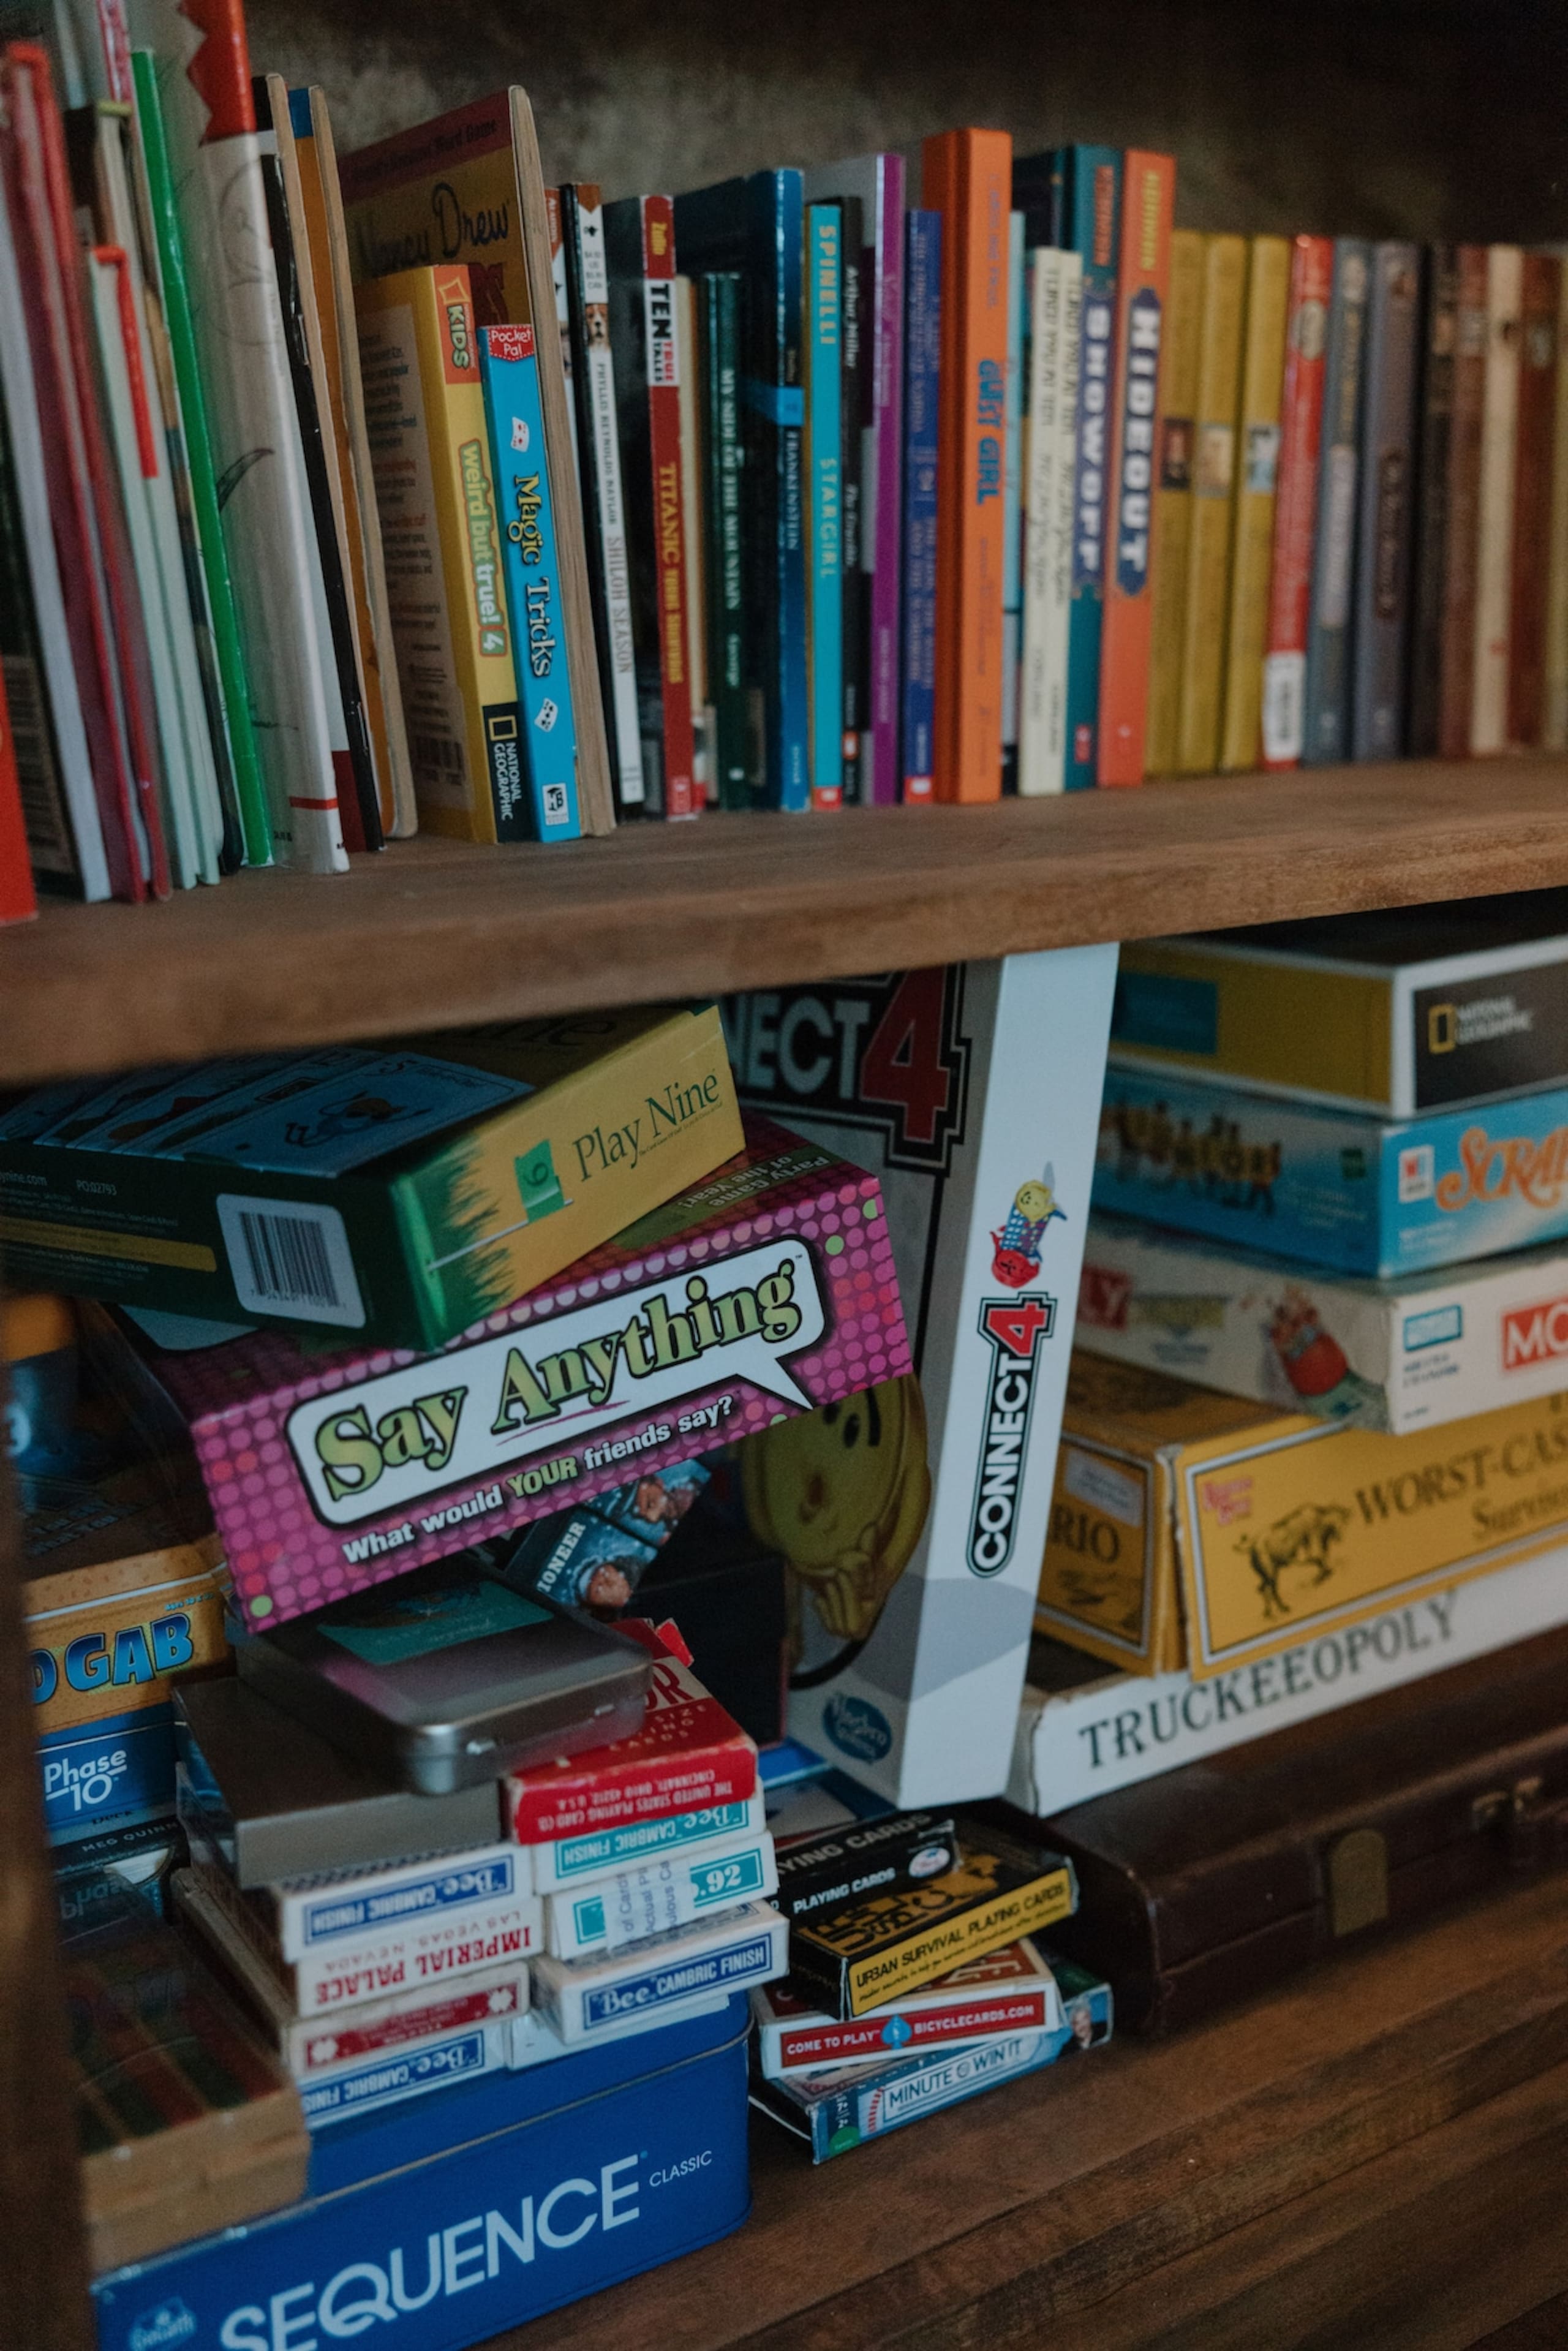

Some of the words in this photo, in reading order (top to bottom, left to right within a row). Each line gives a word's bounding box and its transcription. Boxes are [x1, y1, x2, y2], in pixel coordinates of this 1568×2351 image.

[433, 182, 510, 258] Drew
[819, 225, 837, 345] SPINELLI
[843, 266, 859, 317] Arthur
[491, 329, 532, 344] Pocket
[651, 284, 671, 339] TEN
[448, 304, 470, 370] KIDS
[503, 342, 522, 356] Pal
[653, 342, 663, 381] TALES
[664, 341, 673, 380] TRUE
[844, 319, 859, 368] Miller
[596, 363, 607, 412] PHYLLIS
[719, 369, 736, 396] MY
[600, 415, 614, 475] REYNOLDS
[1079, 306, 1111, 572] SHOWOFF
[1120, 308, 1161, 573] HIDEOUT
[462, 445, 489, 517] weird
[976, 437, 1000, 504] GIRL
[508, 474, 543, 564] Magic
[605, 480, 617, 526] NAYLOR
[658, 462, 680, 565] TITANIC
[819, 458, 839, 578] STARGIRL
[469, 520, 489, 561] but
[475, 563, 501, 624] true!
[606, 537, 625, 601] SHILOH
[483, 632, 503, 651] 4
[525, 577, 556, 677] Tricks
[612, 608, 632, 673] SEASON
[493, 743, 513, 821] GEOGRAPHIC
[506, 742, 521, 804] NATIONAL
[720, 995, 871, 1101] NECT
[861, 964, 949, 1144] 4
[573, 1118, 641, 1182] Play
[645, 1074, 720, 1138] Nine
[730, 1165, 768, 1183] the
[769, 1155, 792, 1169] of
[770, 1156, 830, 1181] Party
[676, 1182, 730, 1209] Year!
[707, 1179, 769, 1206] Game
[985, 1299, 1049, 1357] 4
[315, 1386, 468, 1501] Say
[491, 1259, 802, 1435] Anything
[342, 1522, 415, 1564] What
[420, 1484, 503, 1533] would
[507, 1455, 579, 1498] YOUR
[584, 1423, 672, 1470] friends
[678, 1394, 734, 1434] say?
[973, 1352, 1034, 1572] CONNECT
[536, 1522, 587, 1593] IONEER
[65, 1613, 194, 1691] GAB
[1079, 1585, 1460, 1769] TRUCKEEOPOLY
[44, 1749, 127, 1793] Phase
[73, 1772, 113, 1811] 10
[623, 1781, 652, 1798] OHIO
[673, 1783, 712, 1804] UNITED
[714, 1779, 733, 1796] THE
[554, 1808, 584, 1828] CARD
[587, 1798, 633, 1822] PLAYING
[636, 1792, 671, 1812] STATES
[564, 1836, 611, 1865] FINISH
[614, 1821, 676, 1852] CAMBRIC
[778, 1843, 845, 1876] YING
[843, 1813, 933, 1849] CARDS
[367, 1884, 435, 1919] CAMBRIC
[793, 1884, 850, 1914] PLAYING
[851, 1866, 897, 1893] CARDS
[488, 1911, 521, 1928] LAS
[324, 1945, 405, 1972] NEVADA
[415, 1926, 532, 1976] IMPERIAL
[657, 1961, 717, 1994] CAMBRIC
[720, 1945, 765, 1976] FINISH
[857, 1958, 899, 1988] URBAN
[900, 1930, 965, 1967] SURVIVAL
[968, 1903, 1020, 1936] PLAYING
[316, 1961, 407, 2005] PALACE
[786, 2040, 823, 2056] COME
[825, 2036, 841, 2048] TO
[842, 2030, 875, 2047] PLAY
[913, 2004, 1035, 2036] BICYCLECARDS.COM
[344, 2064, 409, 2100] CAMBRIC
[889, 2067, 953, 2108] MINUTE
[972, 2046, 1007, 2072] WIN
[1008, 2038, 1022, 2056] IT
[221, 2153, 641, 2351] SEQUENCE
[648, 2149, 713, 2189] CLASSIC
